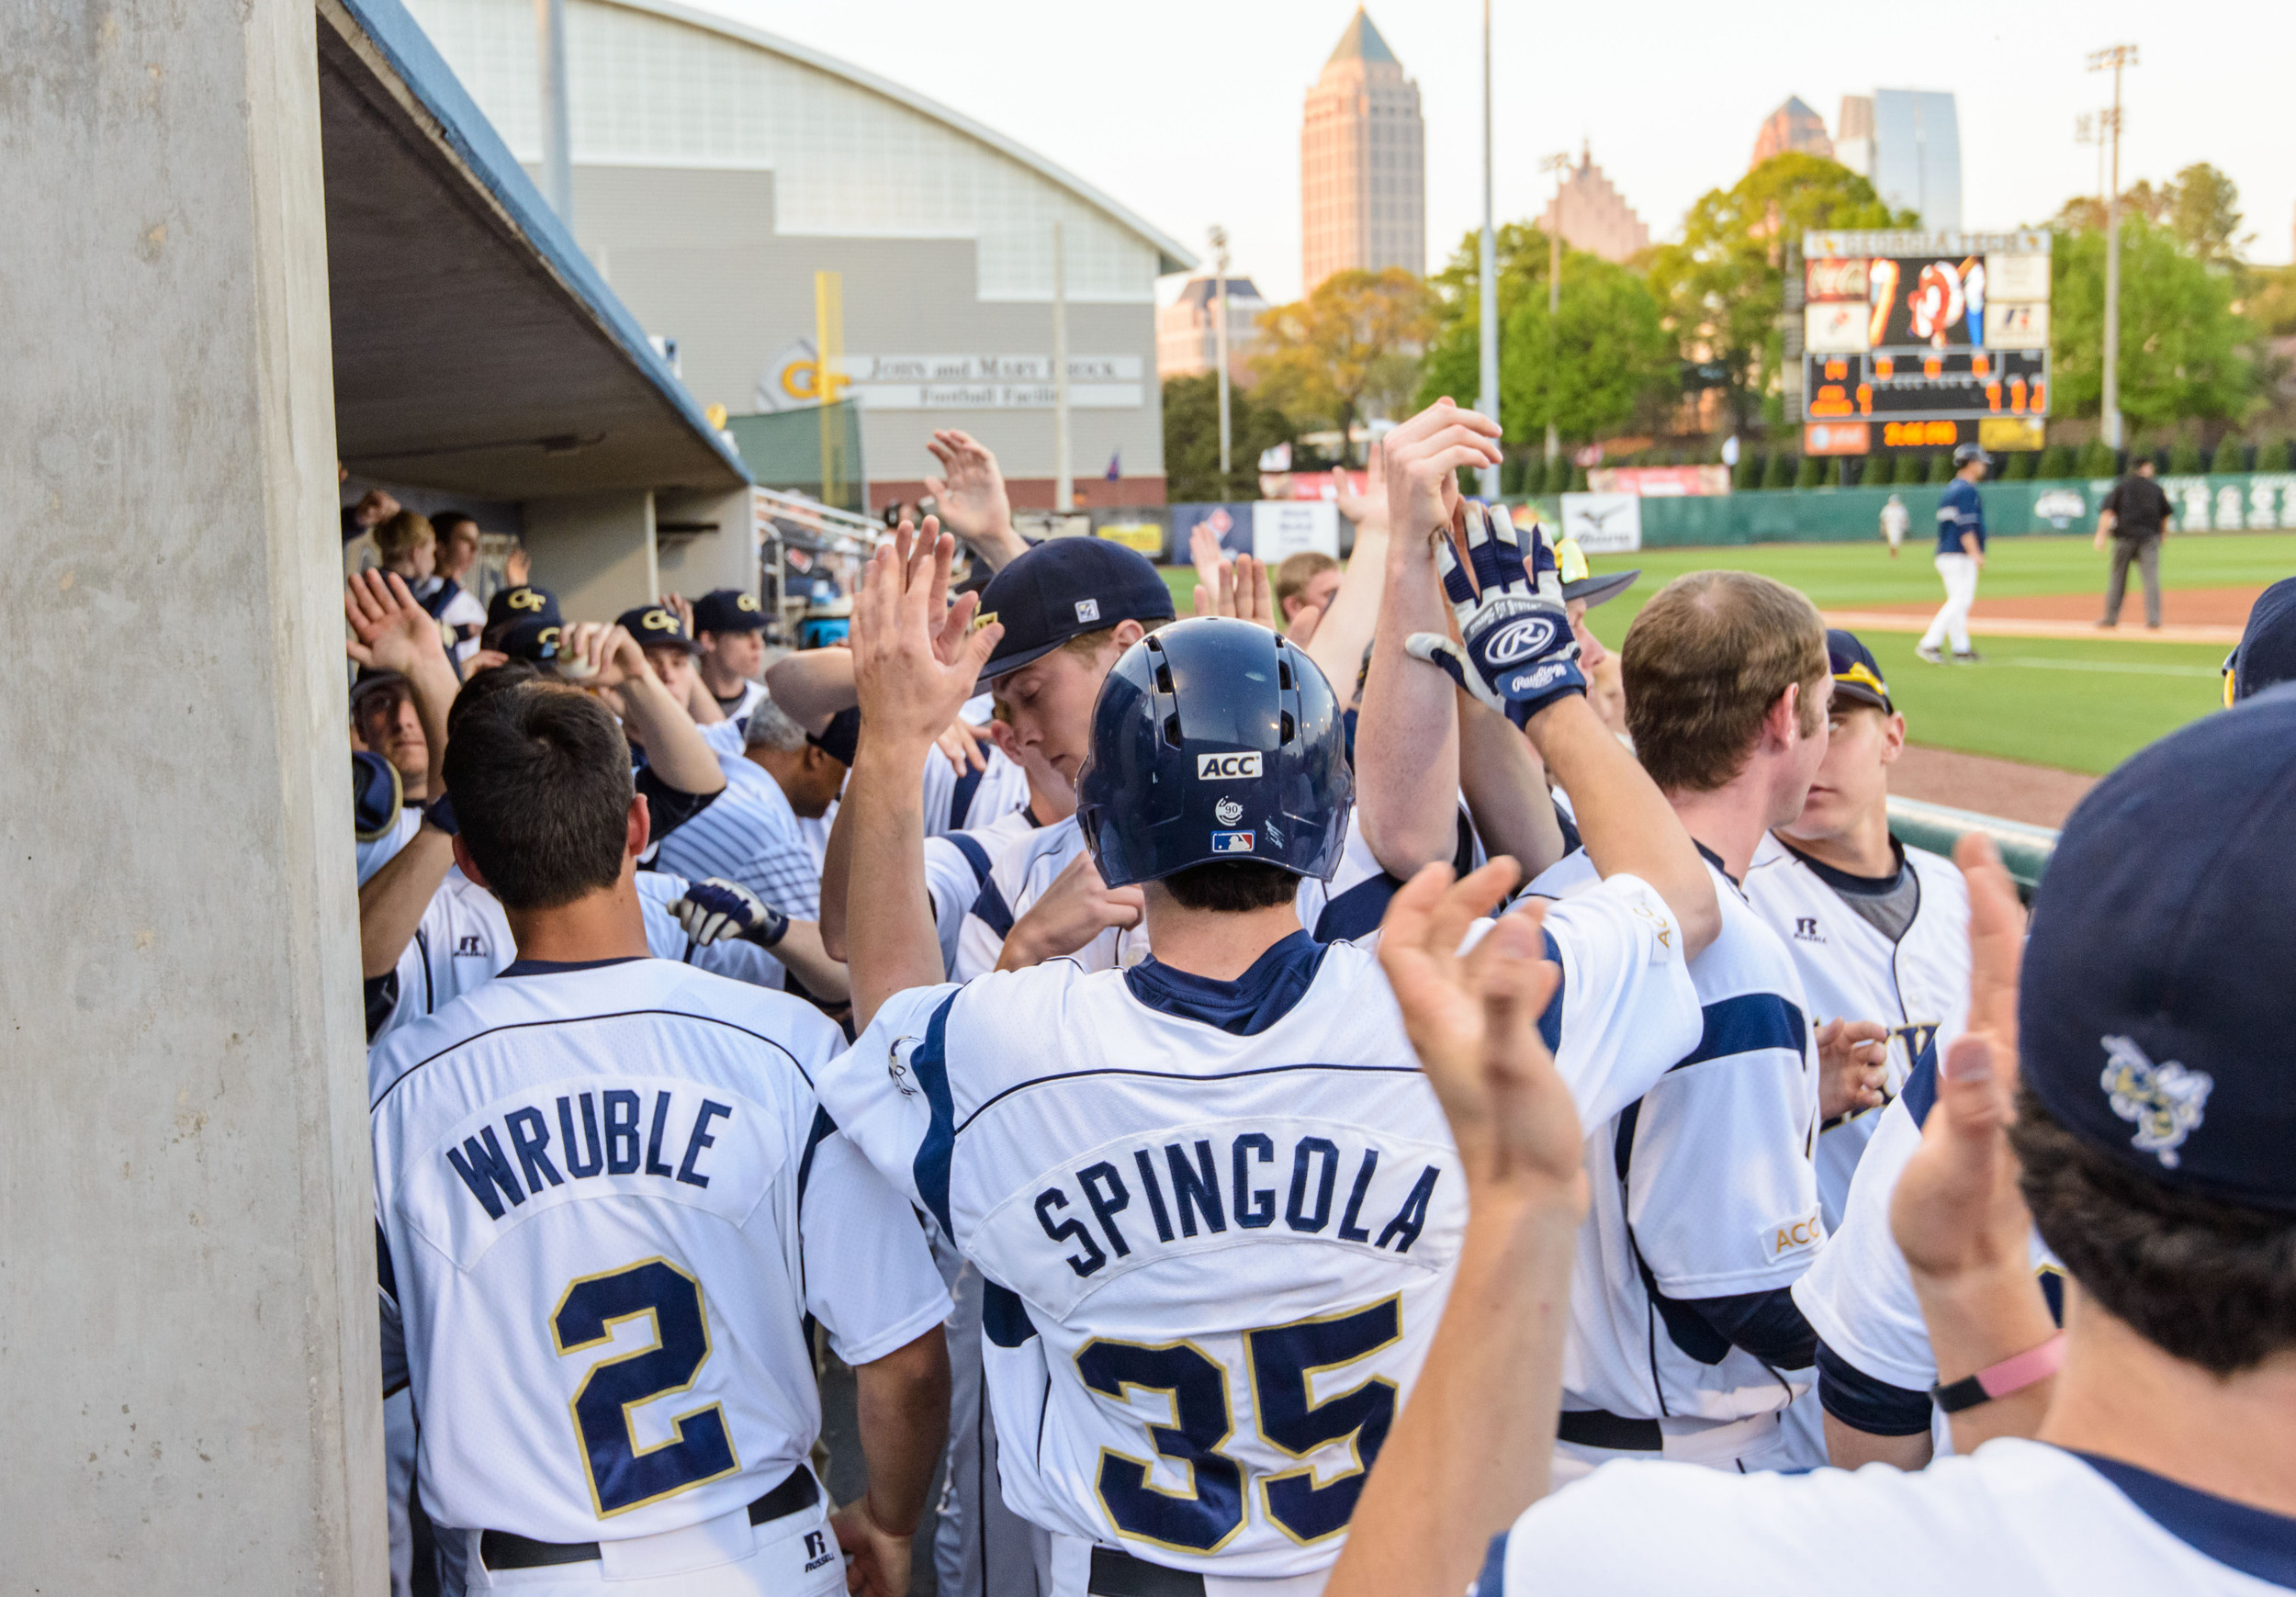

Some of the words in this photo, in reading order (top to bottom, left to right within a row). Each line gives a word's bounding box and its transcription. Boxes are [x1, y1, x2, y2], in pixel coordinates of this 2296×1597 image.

[1512, 663, 1567, 692] Rawlings
[1200, 756, 1255, 778] ACC
[445, 1089, 733, 1221] WRUBLE
[1034, 1132, 1441, 1277] SPINGOLA
[547, 1254, 743, 1522] 2
[1073, 1289, 1403, 1556] 35
[805, 1553, 835, 1573] RUSSELL
